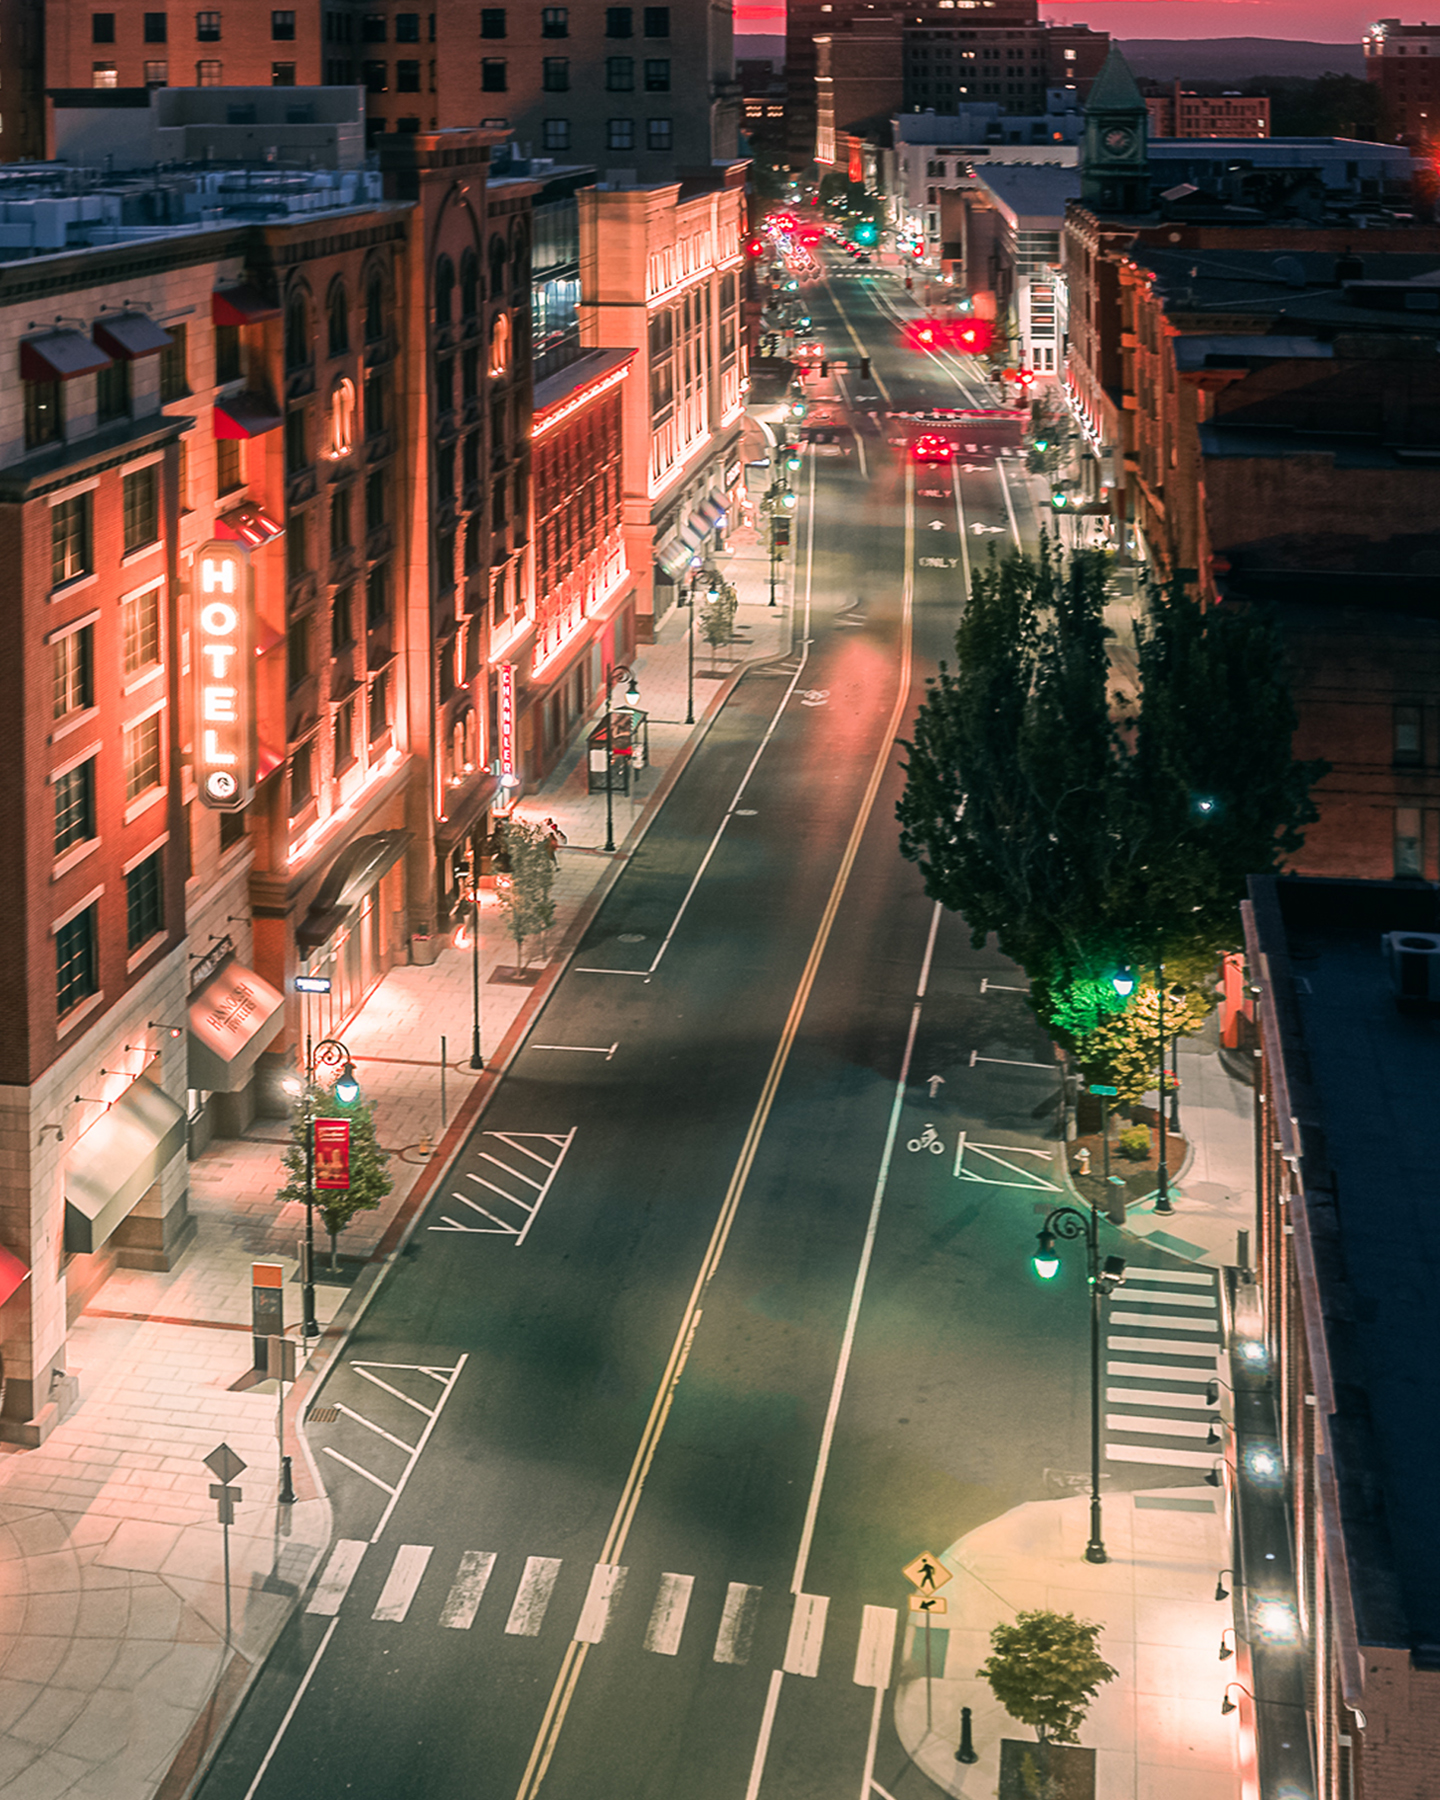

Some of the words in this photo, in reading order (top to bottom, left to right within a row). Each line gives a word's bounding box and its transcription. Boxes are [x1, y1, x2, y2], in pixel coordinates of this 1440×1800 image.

[918, 557, 958, 568] ONLY
[200, 558, 237, 765] HOTEL
[502, 672, 512, 773] CHANDLER
[206, 981, 254, 1031] HANNOUSH
